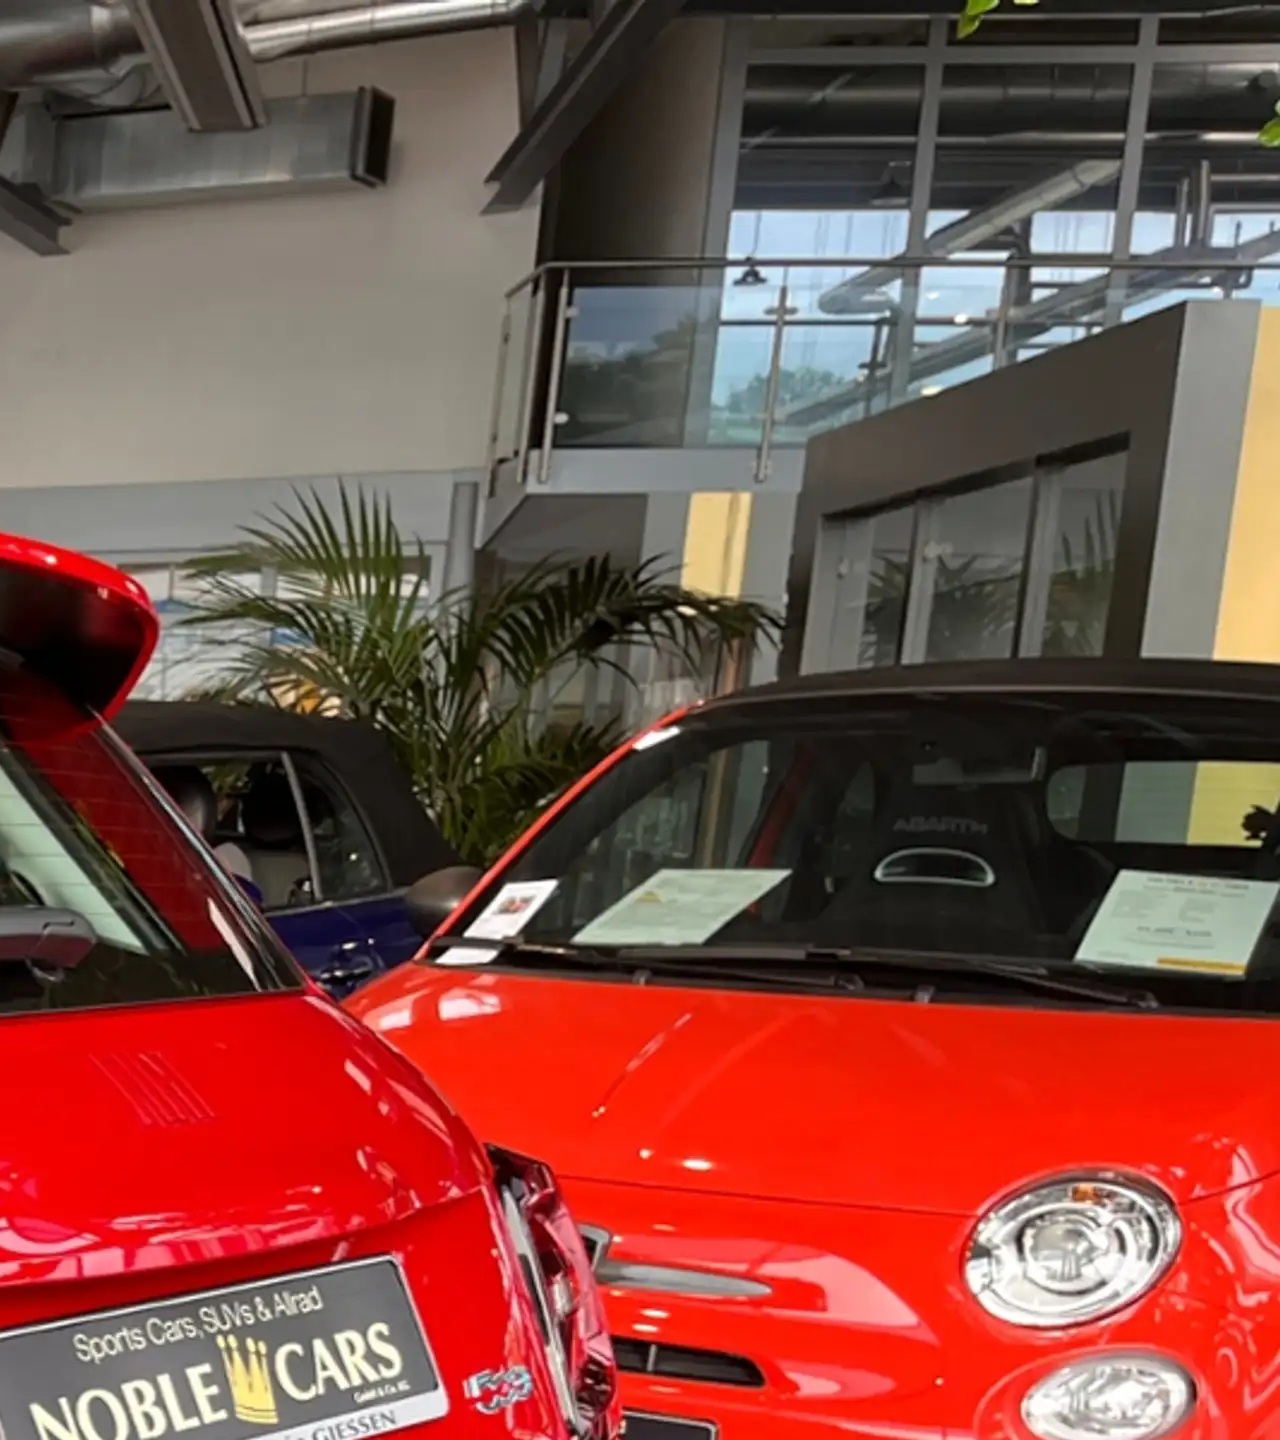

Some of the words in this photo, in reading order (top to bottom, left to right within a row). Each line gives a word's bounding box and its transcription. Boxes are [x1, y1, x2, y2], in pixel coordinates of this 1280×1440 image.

[73, 1326, 146, 1364] Sports
[199, 1303, 255, 1334] SUVs
[256, 1296, 273, 1322] &
[274, 1322, 403, 1401] CARS
